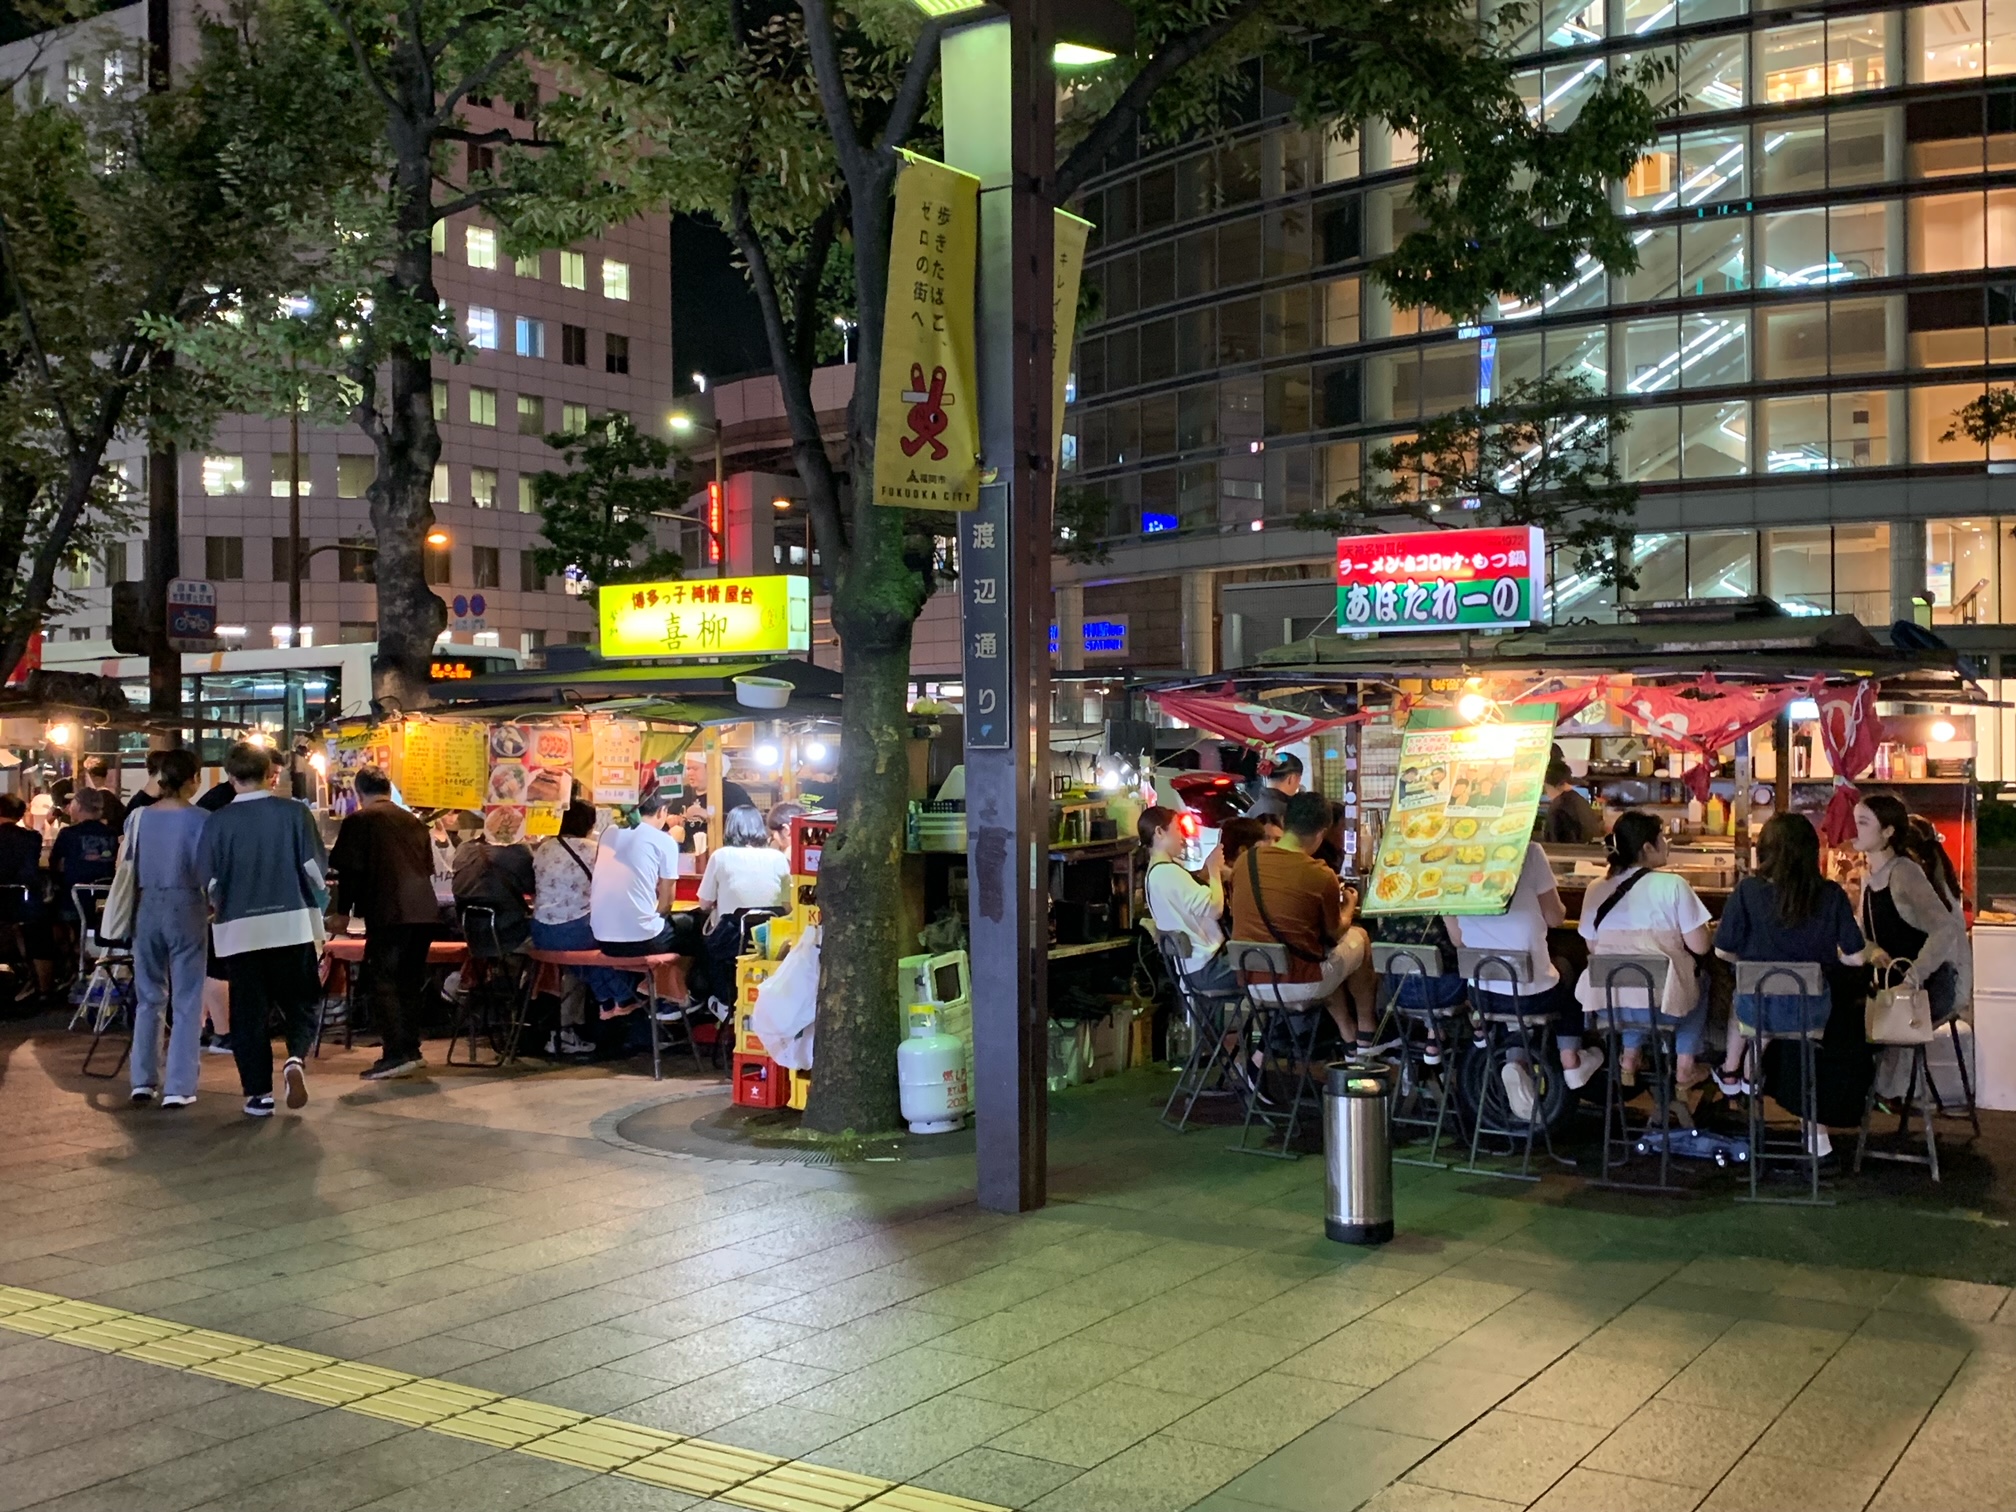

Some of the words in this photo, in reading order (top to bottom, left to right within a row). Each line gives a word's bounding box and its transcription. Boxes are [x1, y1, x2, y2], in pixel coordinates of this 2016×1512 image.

[881, 486, 937, 500] FUKUOKA
[943, 492, 971, 502] CITY
[972, 522, 997, 715] 渡辺通り
[1346, 576, 1519, 623] あほたれーの
[660, 611, 728, 651] 喜柳
